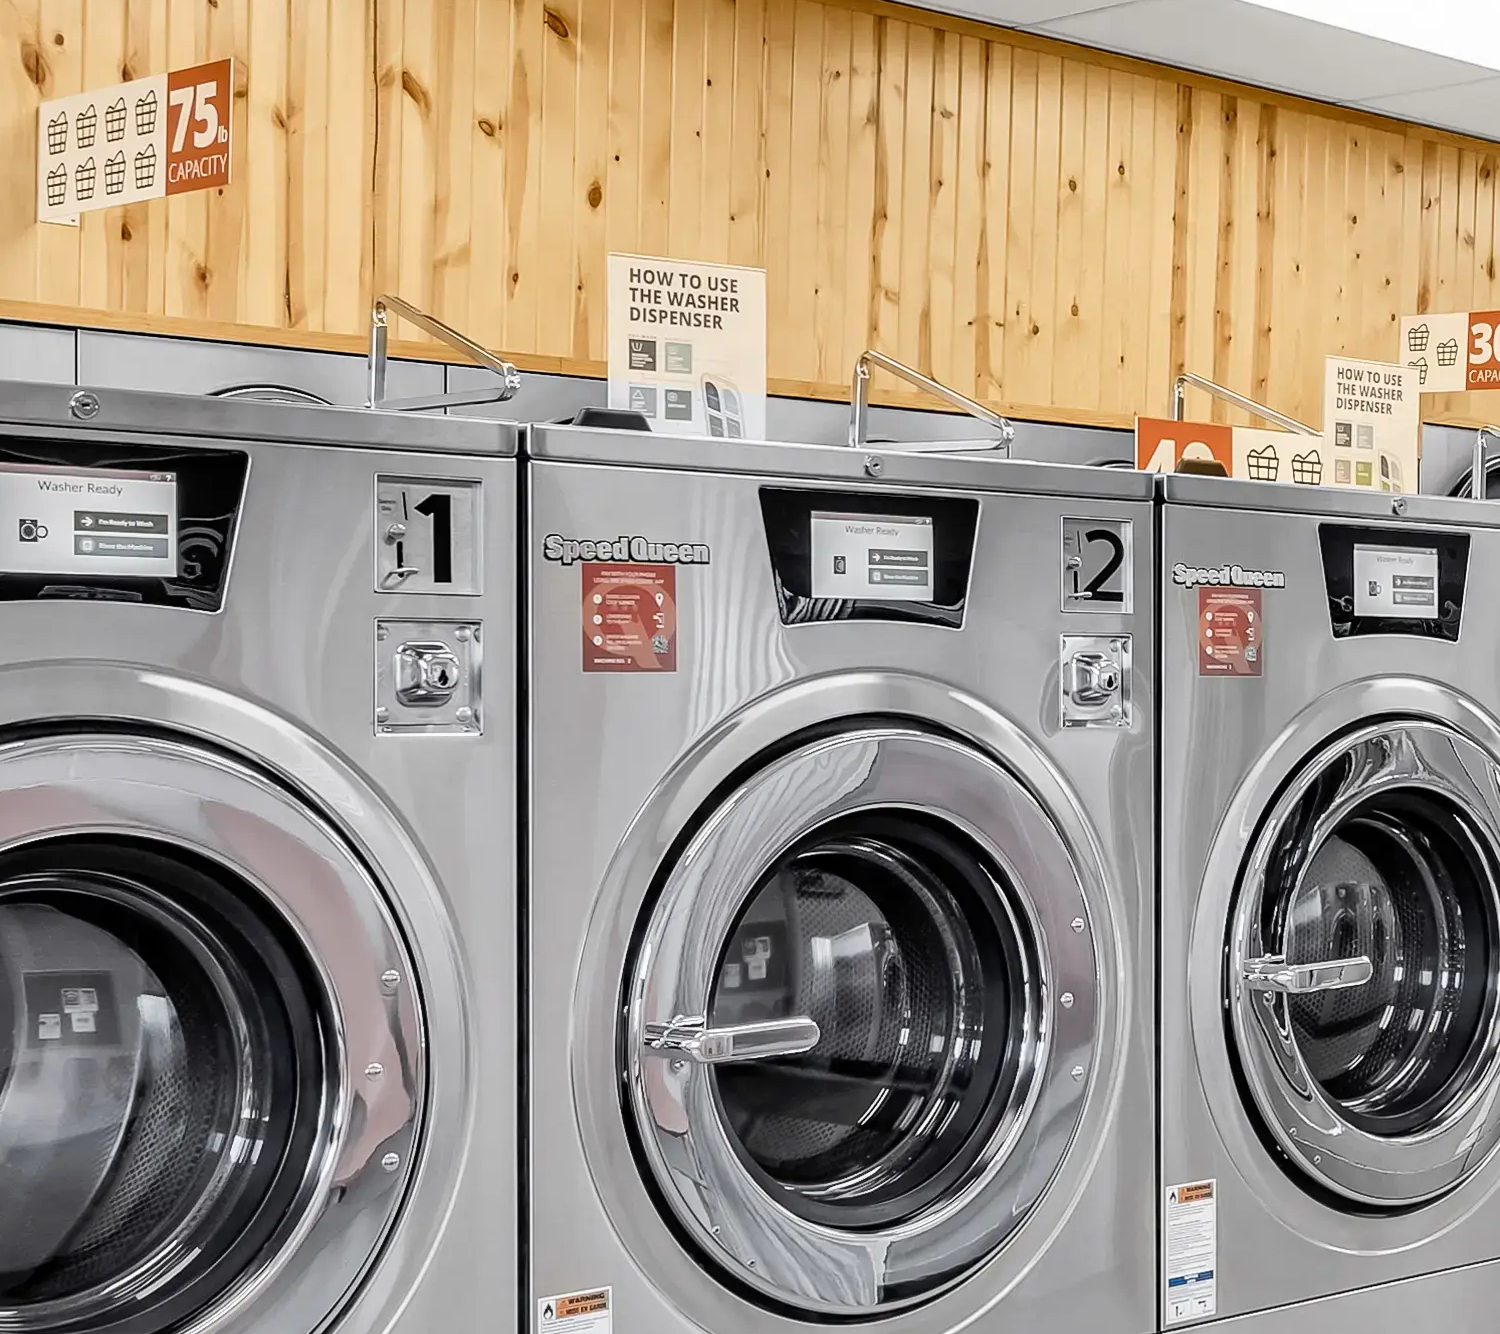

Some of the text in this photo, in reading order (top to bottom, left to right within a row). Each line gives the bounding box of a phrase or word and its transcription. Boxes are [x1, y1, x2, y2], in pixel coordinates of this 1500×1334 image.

[168, 153, 228, 183] CAPACITY
[629, 267, 738, 293] HOW TO USE
[628, 287, 740, 313] THE WASHER
[629, 306, 723, 330] DISPENSER
[1337, 366, 1403, 387] HOW TO USE
[1336, 382, 1403, 402] THE WASHER
[1336, 397, 1393, 415] DISPENSER
[37, 479, 124, 497] Washer Ready
[414, 494, 452, 583] 1
[845, 524, 874, 536] Washer
[544, 533, 710, 565] Speed Queen
[1083, 529, 1124, 603] 2
[1172, 562, 1286, 589] Speed Queen
